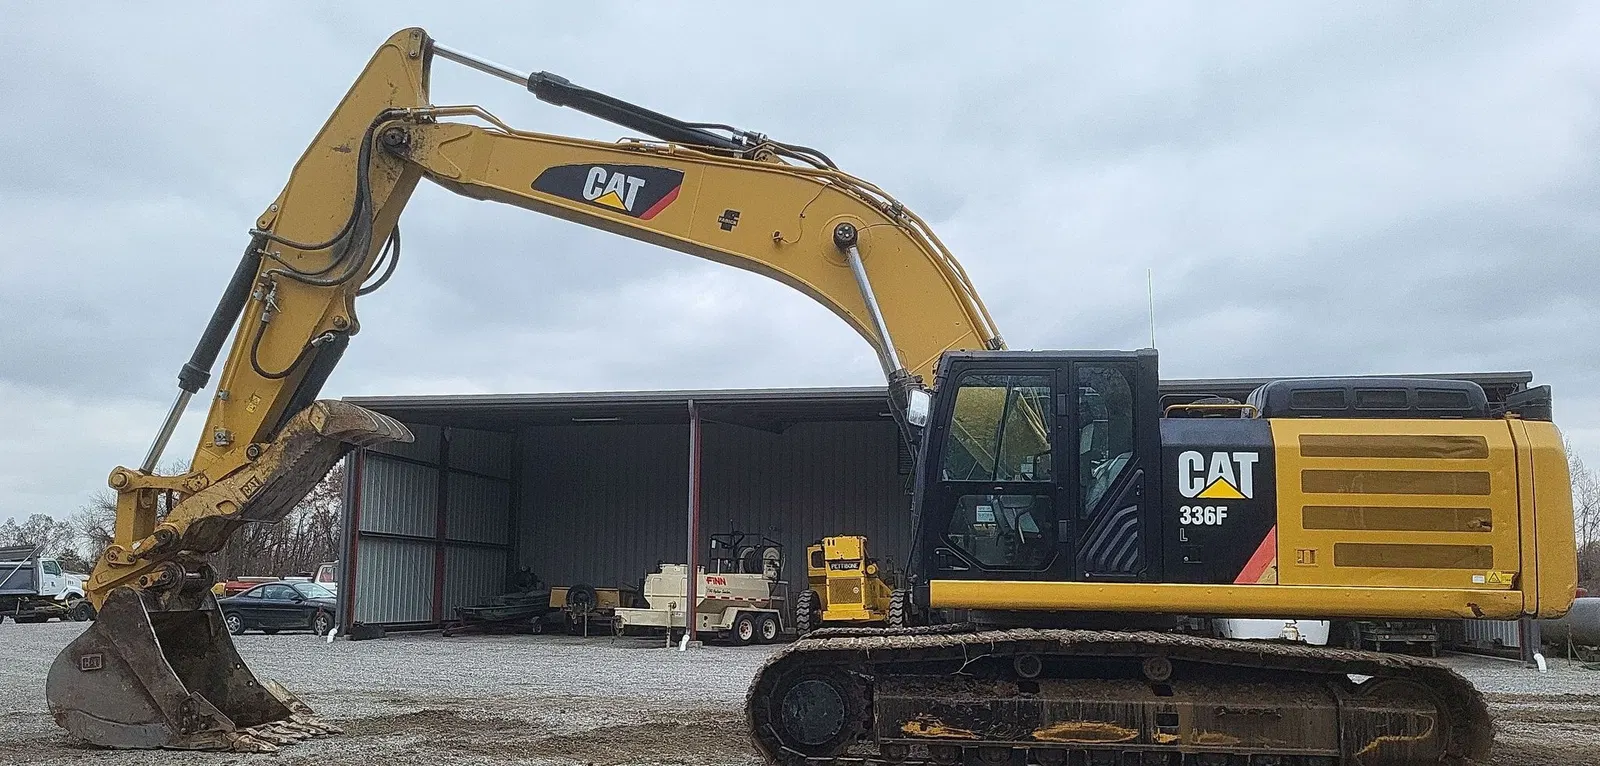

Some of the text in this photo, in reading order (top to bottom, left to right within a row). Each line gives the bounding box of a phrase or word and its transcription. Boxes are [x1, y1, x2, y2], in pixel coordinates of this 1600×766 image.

[583, 166, 645, 211] CAT
[1178, 450, 1259, 499] CAT
[242, 477, 261, 496] CAT
[1180, 506, 1228, 525] 336F
[1179, 527, 1188, 541] L
[706, 577, 727, 585] FINN
